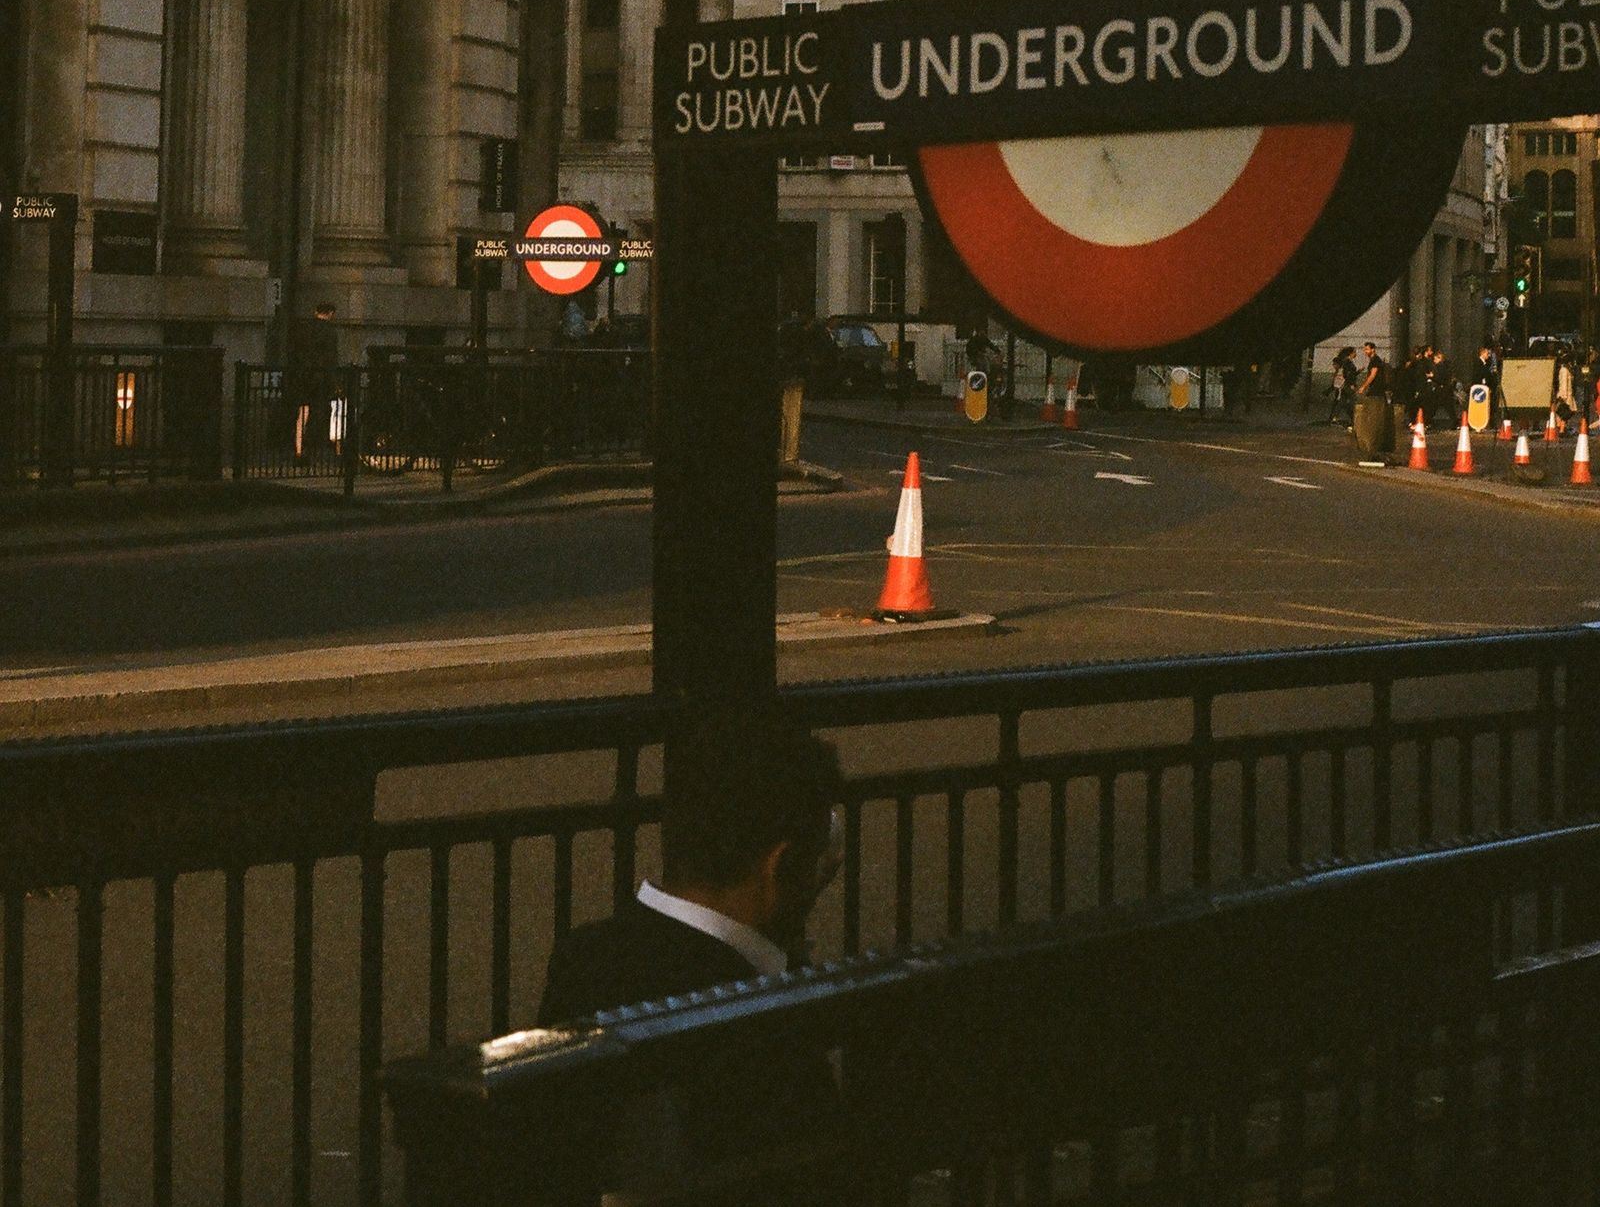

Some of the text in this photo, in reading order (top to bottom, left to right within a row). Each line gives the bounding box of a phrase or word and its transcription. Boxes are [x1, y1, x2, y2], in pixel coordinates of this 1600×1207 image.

[687, 31, 819, 83] PUBLIC
[675, 82, 830, 134] SUBWAY
[16, 196, 54, 207] PUBLIC
[13, 207, 57, 218] SUBWAY
[477, 240, 506, 249] PUBLIC
[516, 243, 611, 255] UNDERGROUND
[621, 240, 651, 249] PUBLIC
[474, 248, 508, 257] SUBWAY
[619, 249, 653, 258] SUBWAY
